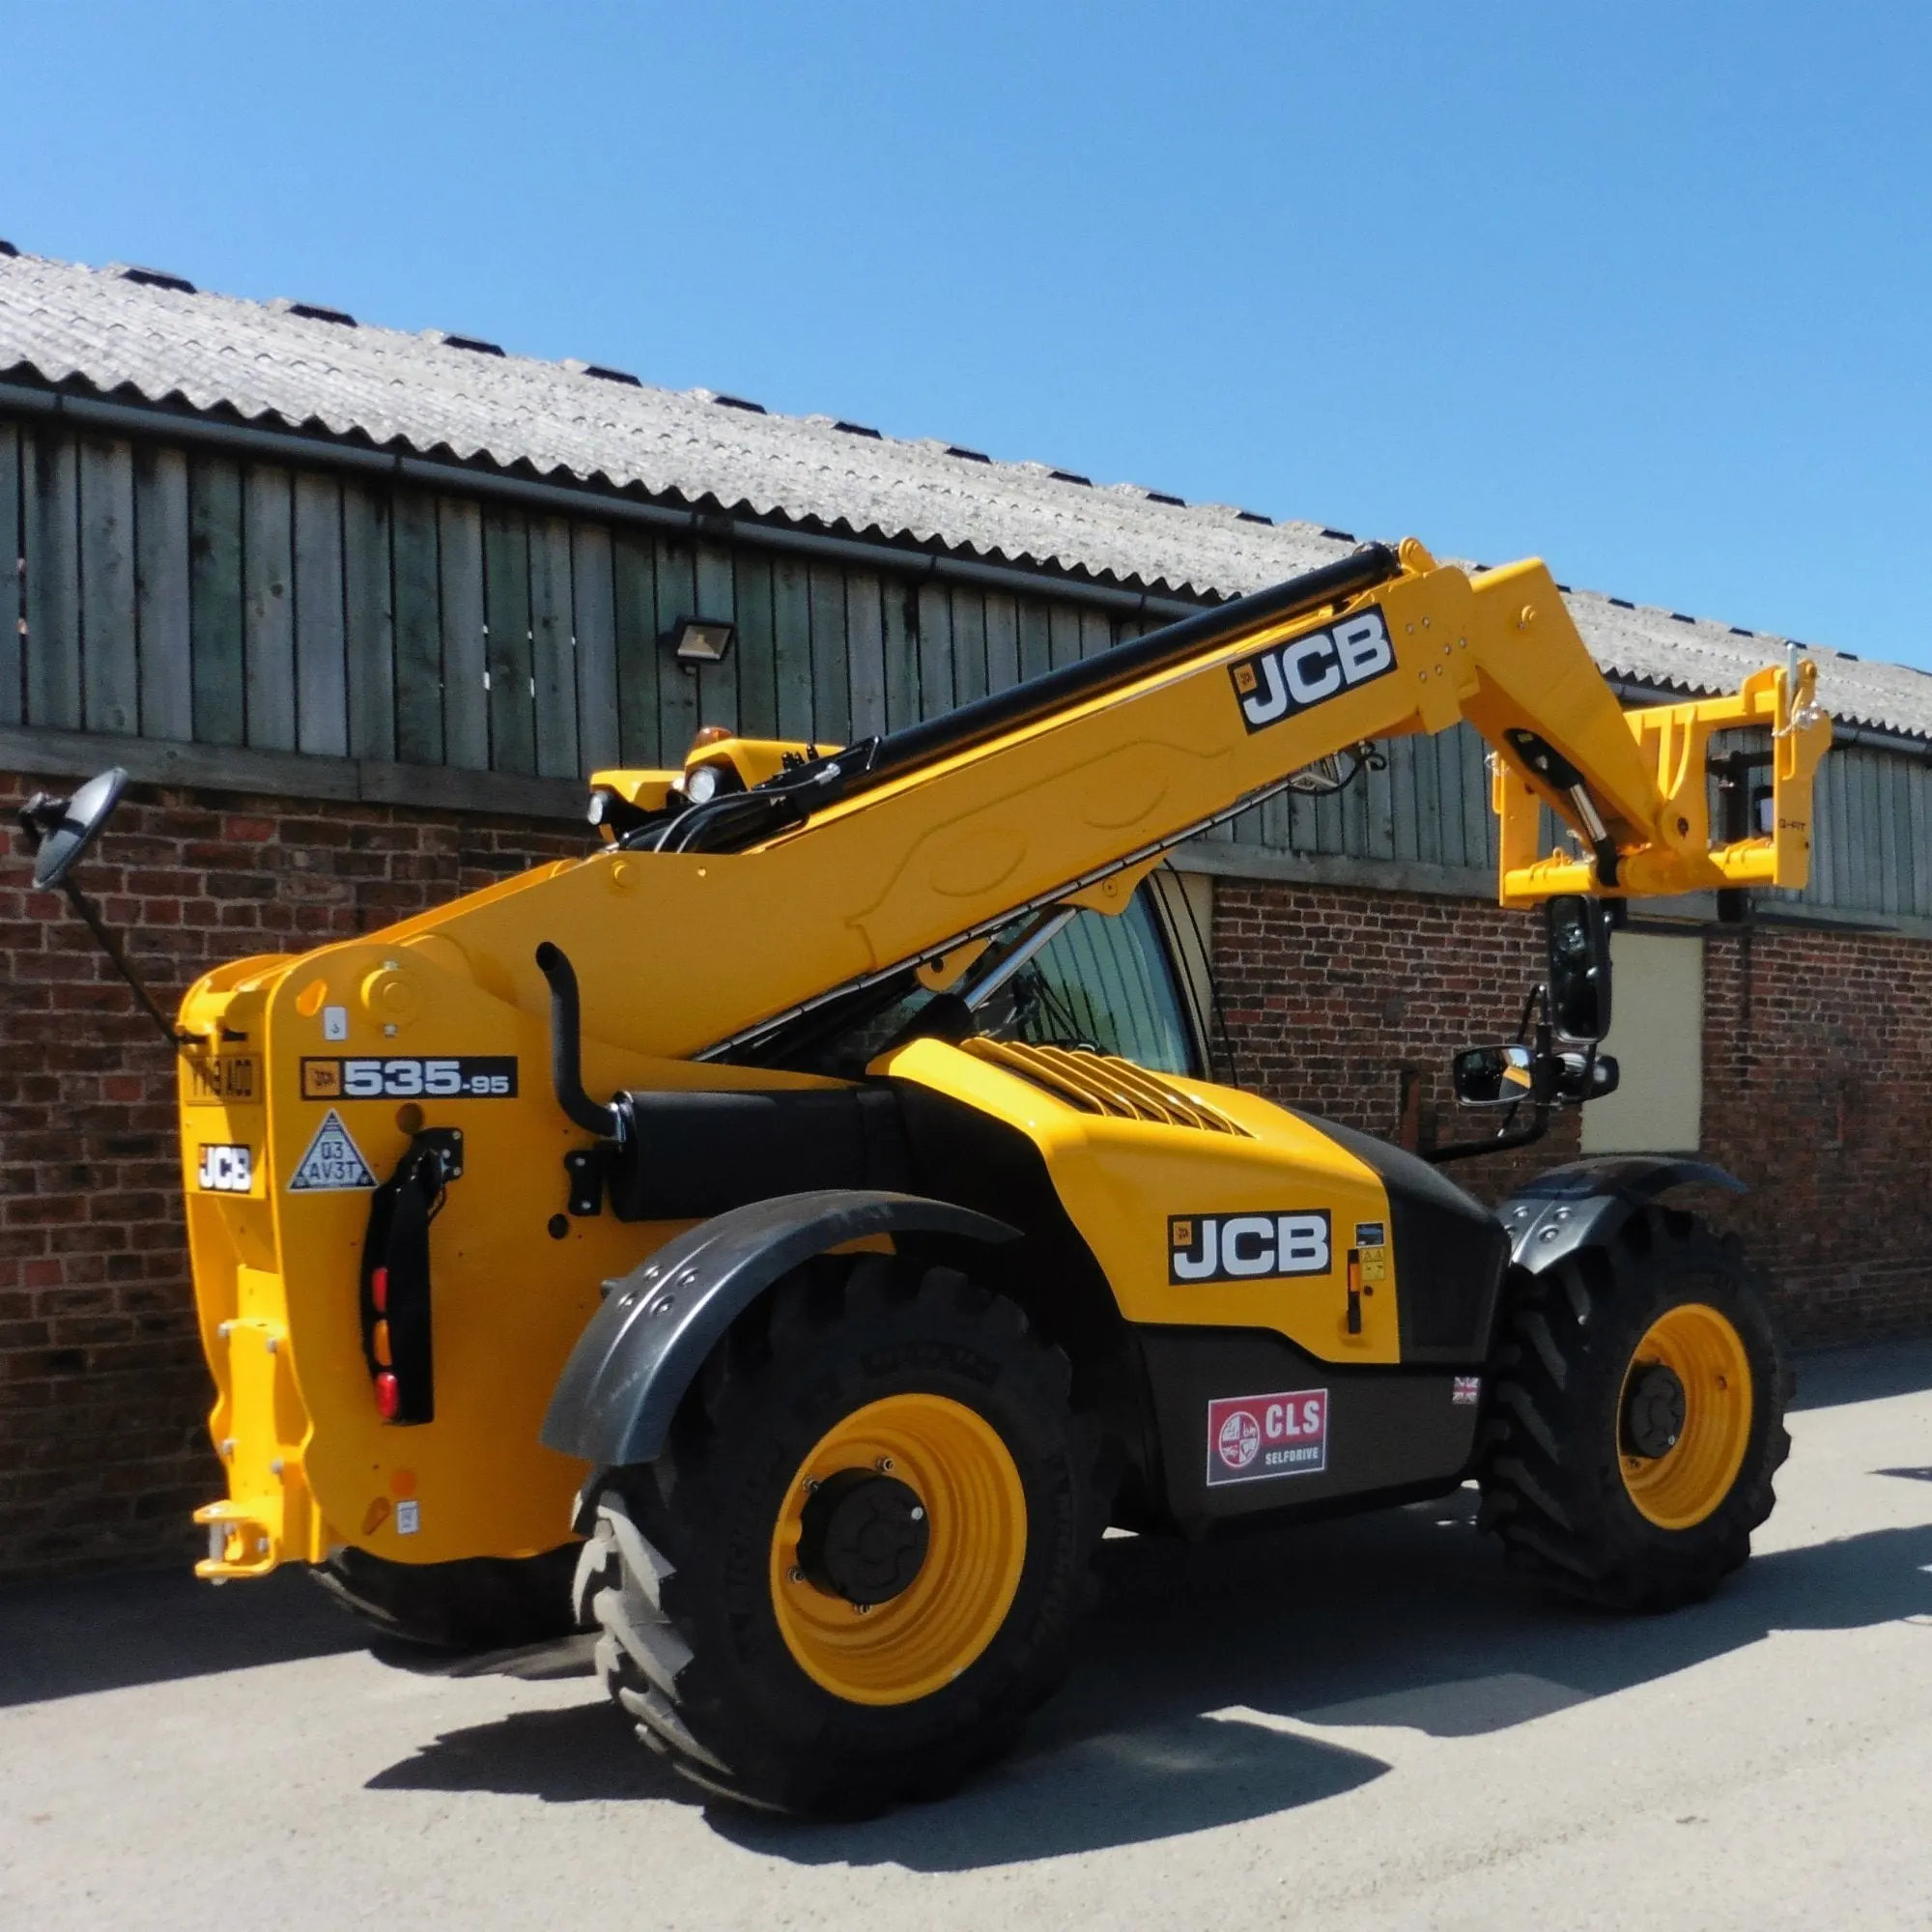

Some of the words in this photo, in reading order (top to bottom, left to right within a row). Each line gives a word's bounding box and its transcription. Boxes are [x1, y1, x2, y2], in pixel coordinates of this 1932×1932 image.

[1243, 613, 1391, 724] JCB
[199, 1147, 251, 1190] JCB
[309, 1161, 357, 1179] AV3T
[1174, 1215, 1329, 1279] JCB
[1265, 1400, 1320, 1438] CLS
[1264, 1447, 1320, 1465] SELFDRIVE
